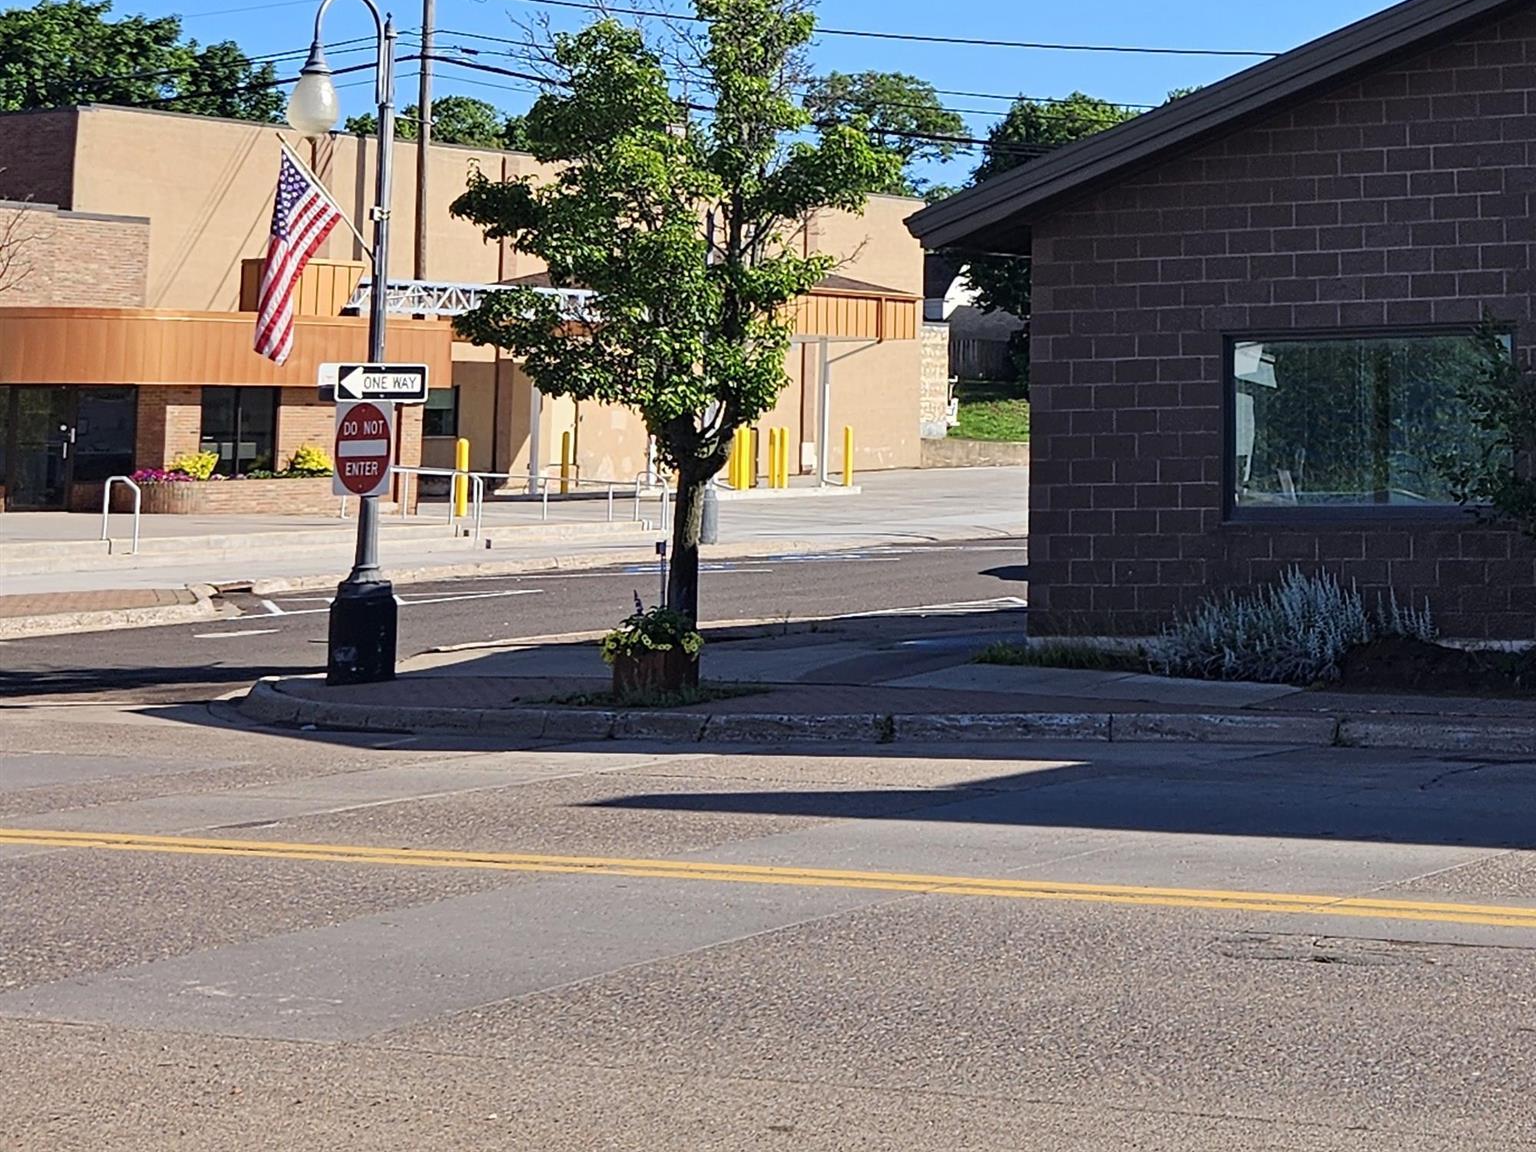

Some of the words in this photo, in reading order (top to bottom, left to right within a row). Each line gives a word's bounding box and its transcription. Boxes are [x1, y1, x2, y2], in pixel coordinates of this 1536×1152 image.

[363, 376, 388, 390] ONE
[393, 376, 417, 390] WAY
[343, 421, 358, 436] DO
[363, 420, 385, 435] NOT
[345, 461, 379, 476] ENTER
